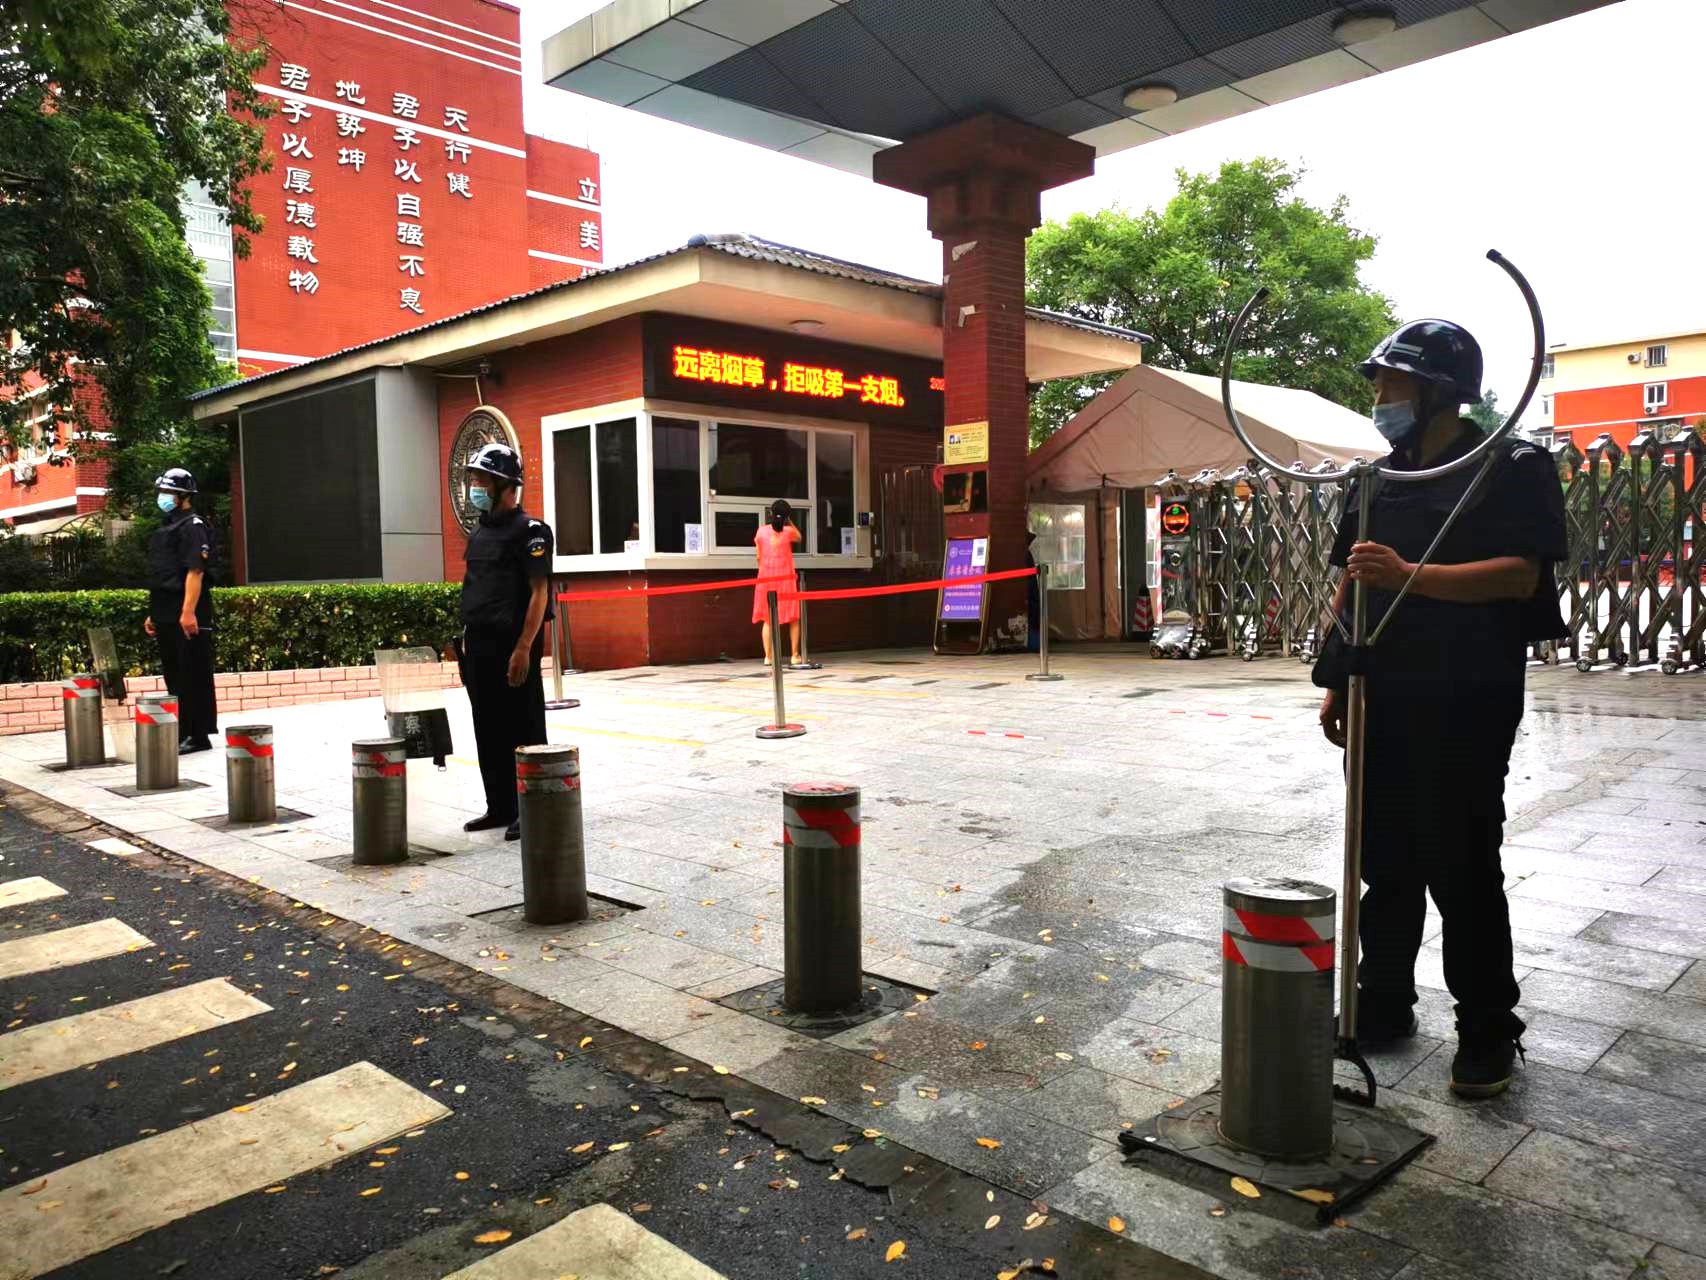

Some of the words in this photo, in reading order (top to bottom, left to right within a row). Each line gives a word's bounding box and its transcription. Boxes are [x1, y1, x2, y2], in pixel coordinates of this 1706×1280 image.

[279, 62, 320, 295] 君子以厚德载物
[335, 80, 367, 172] 地势坤
[392, 92, 425, 314] 君子以自强不息
[444, 106, 473, 198] 天行健
